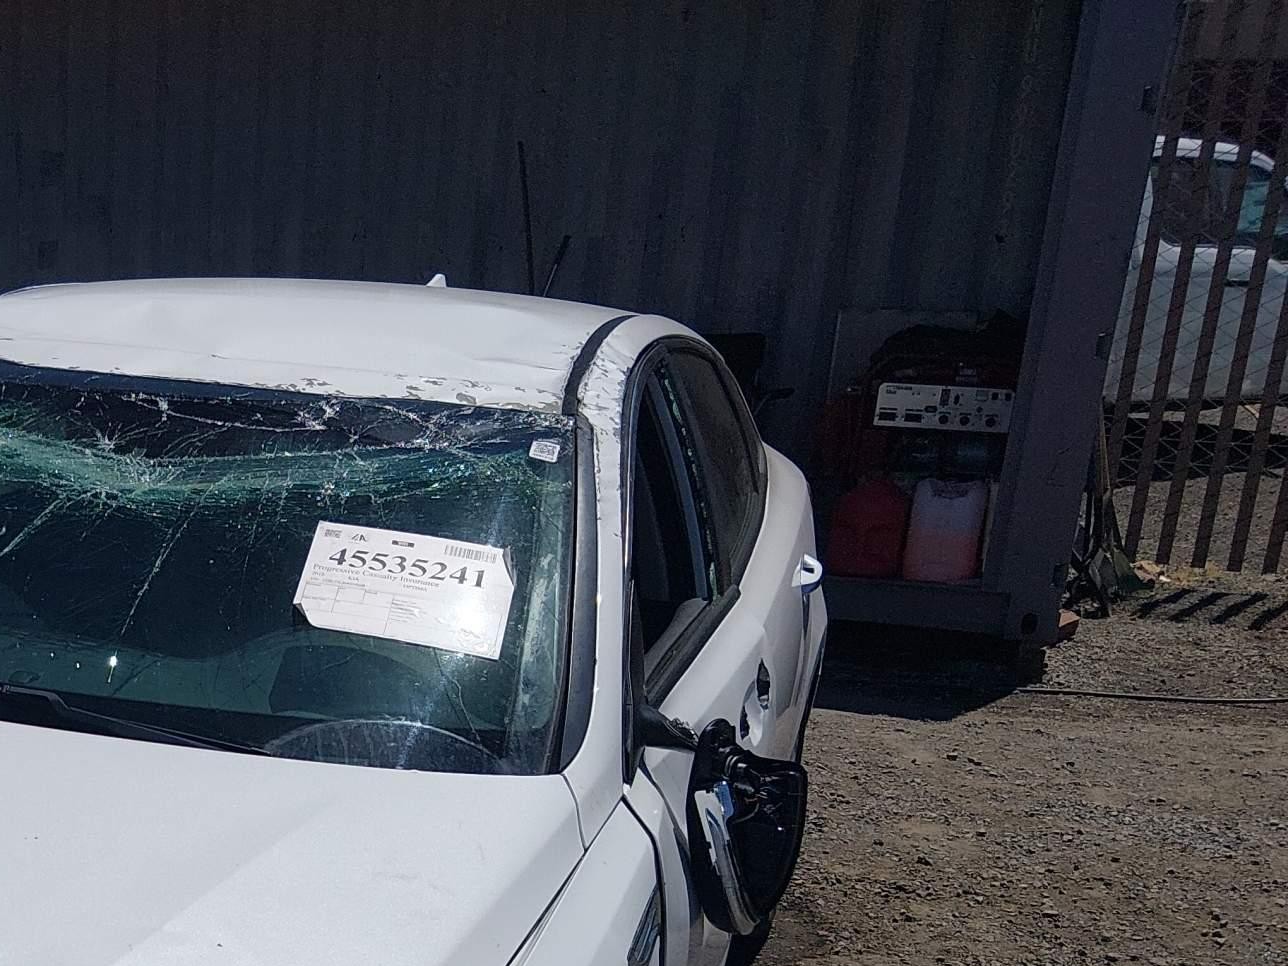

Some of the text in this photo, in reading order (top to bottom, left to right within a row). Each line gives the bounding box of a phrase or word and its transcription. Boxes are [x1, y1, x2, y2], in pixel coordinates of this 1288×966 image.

[312, 563, 440, 588] Progressive Casualty Insurance
[328, 548, 485, 588] 45535241
